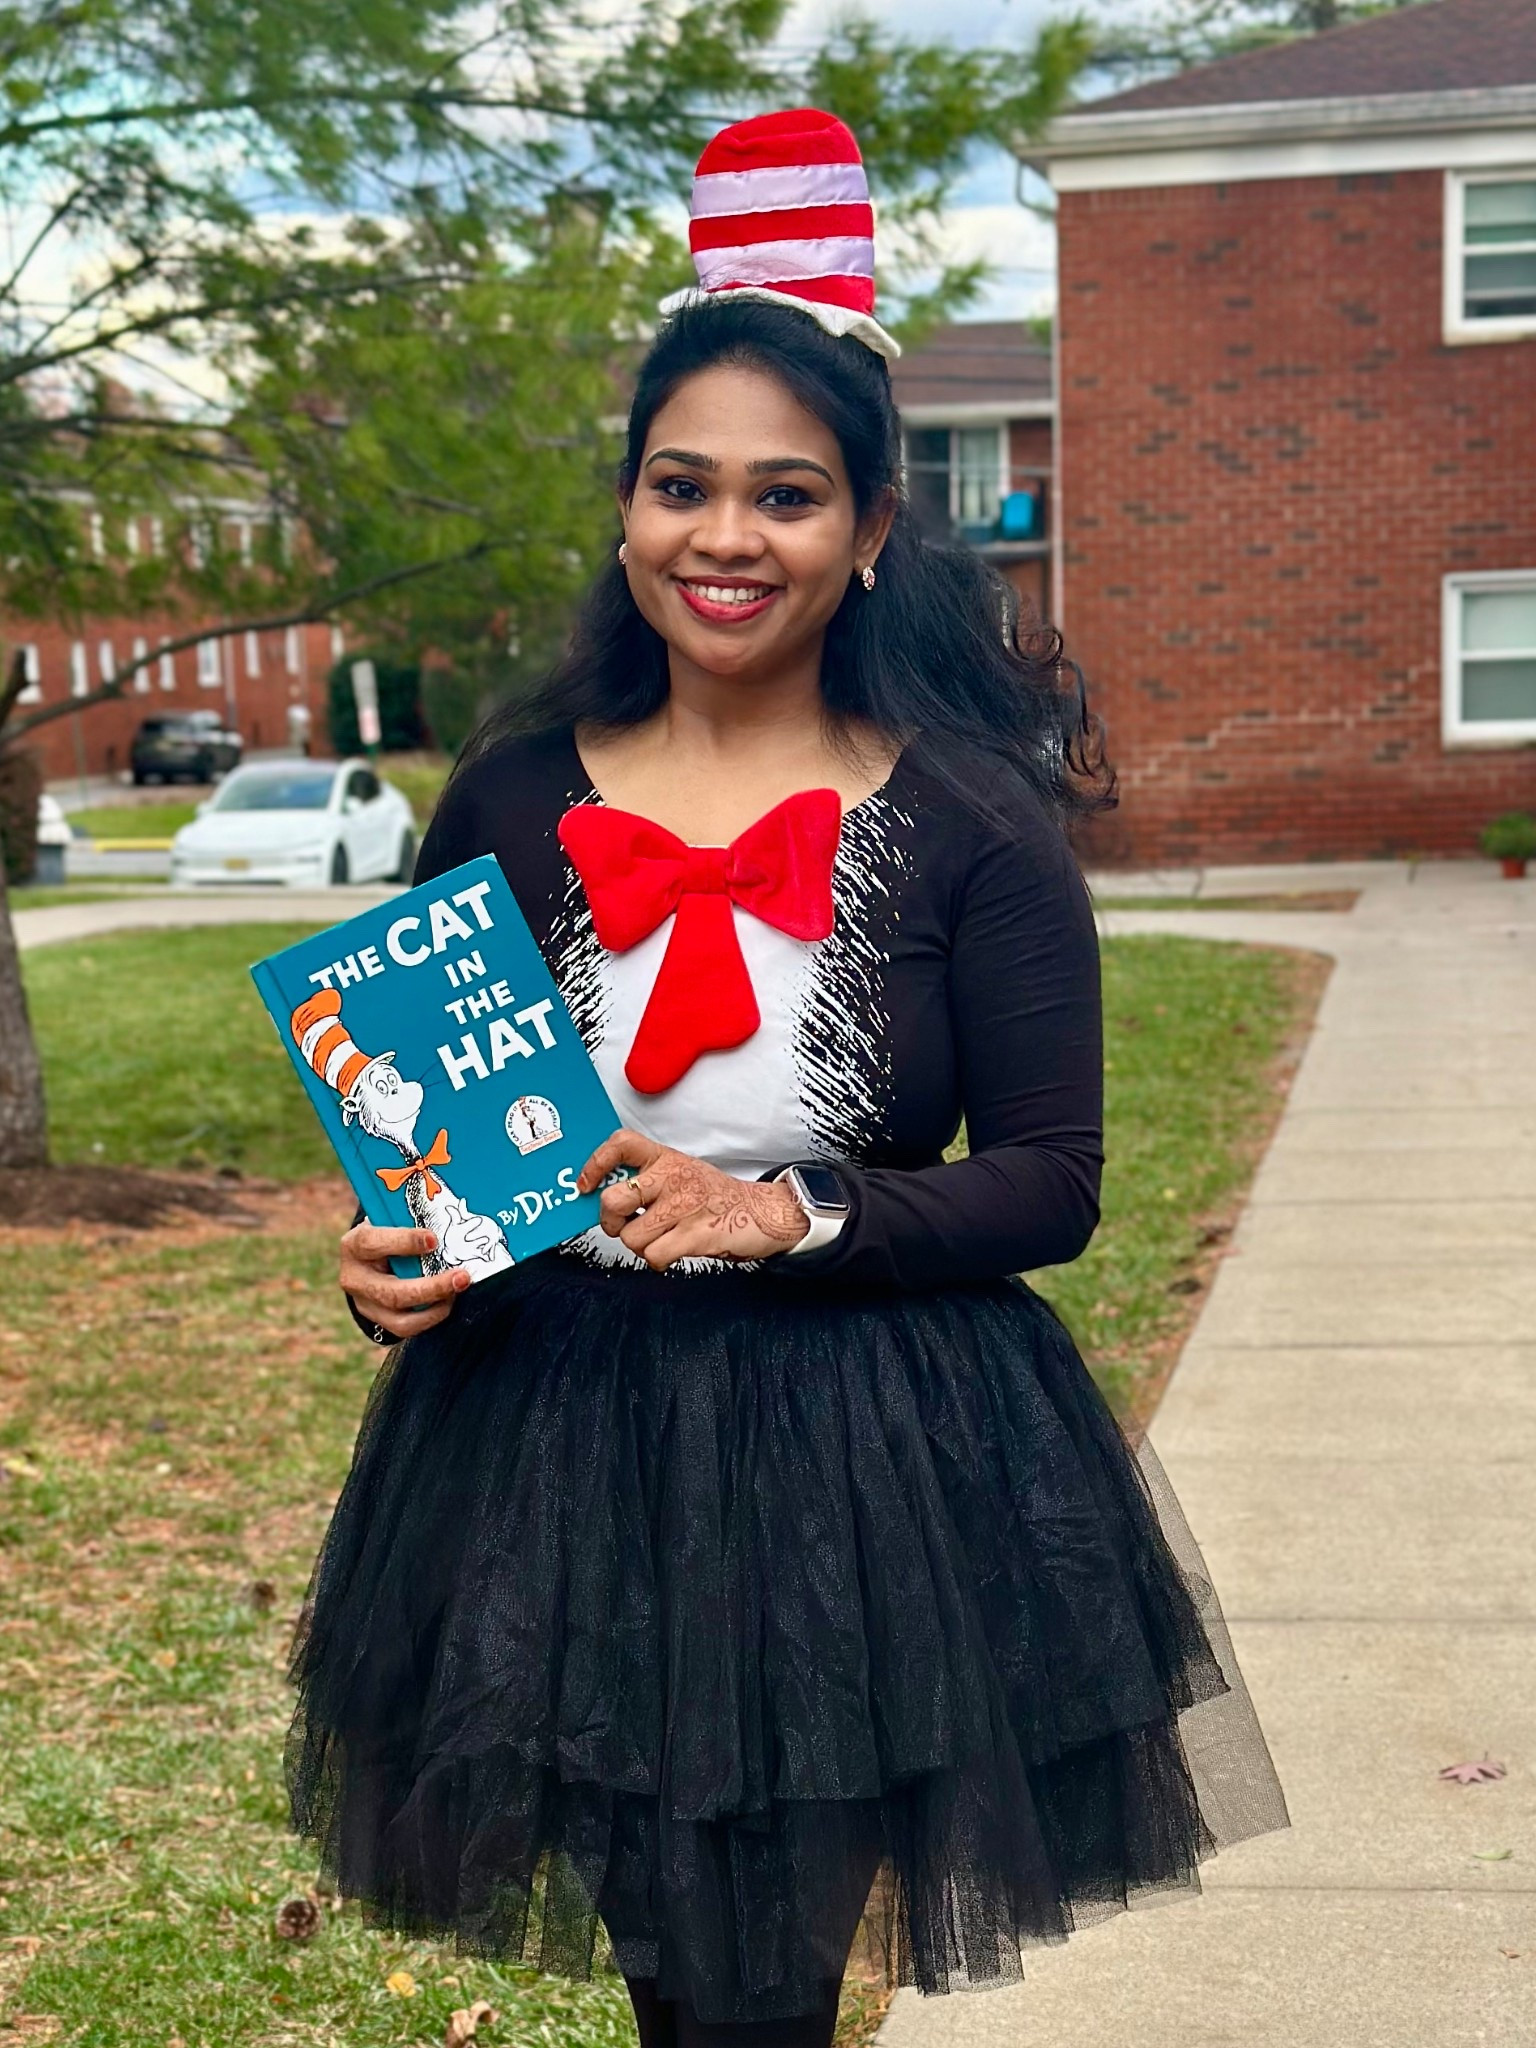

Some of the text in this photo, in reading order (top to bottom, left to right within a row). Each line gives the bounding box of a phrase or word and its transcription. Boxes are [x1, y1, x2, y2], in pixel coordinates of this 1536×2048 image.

[308, 880, 494, 989] THE CAT
[444, 950, 487, 988] IN
[444, 979, 515, 1025] THE
[436, 998, 557, 1091] HAT
[496, 1167, 629, 1226] By Dr. Sss
